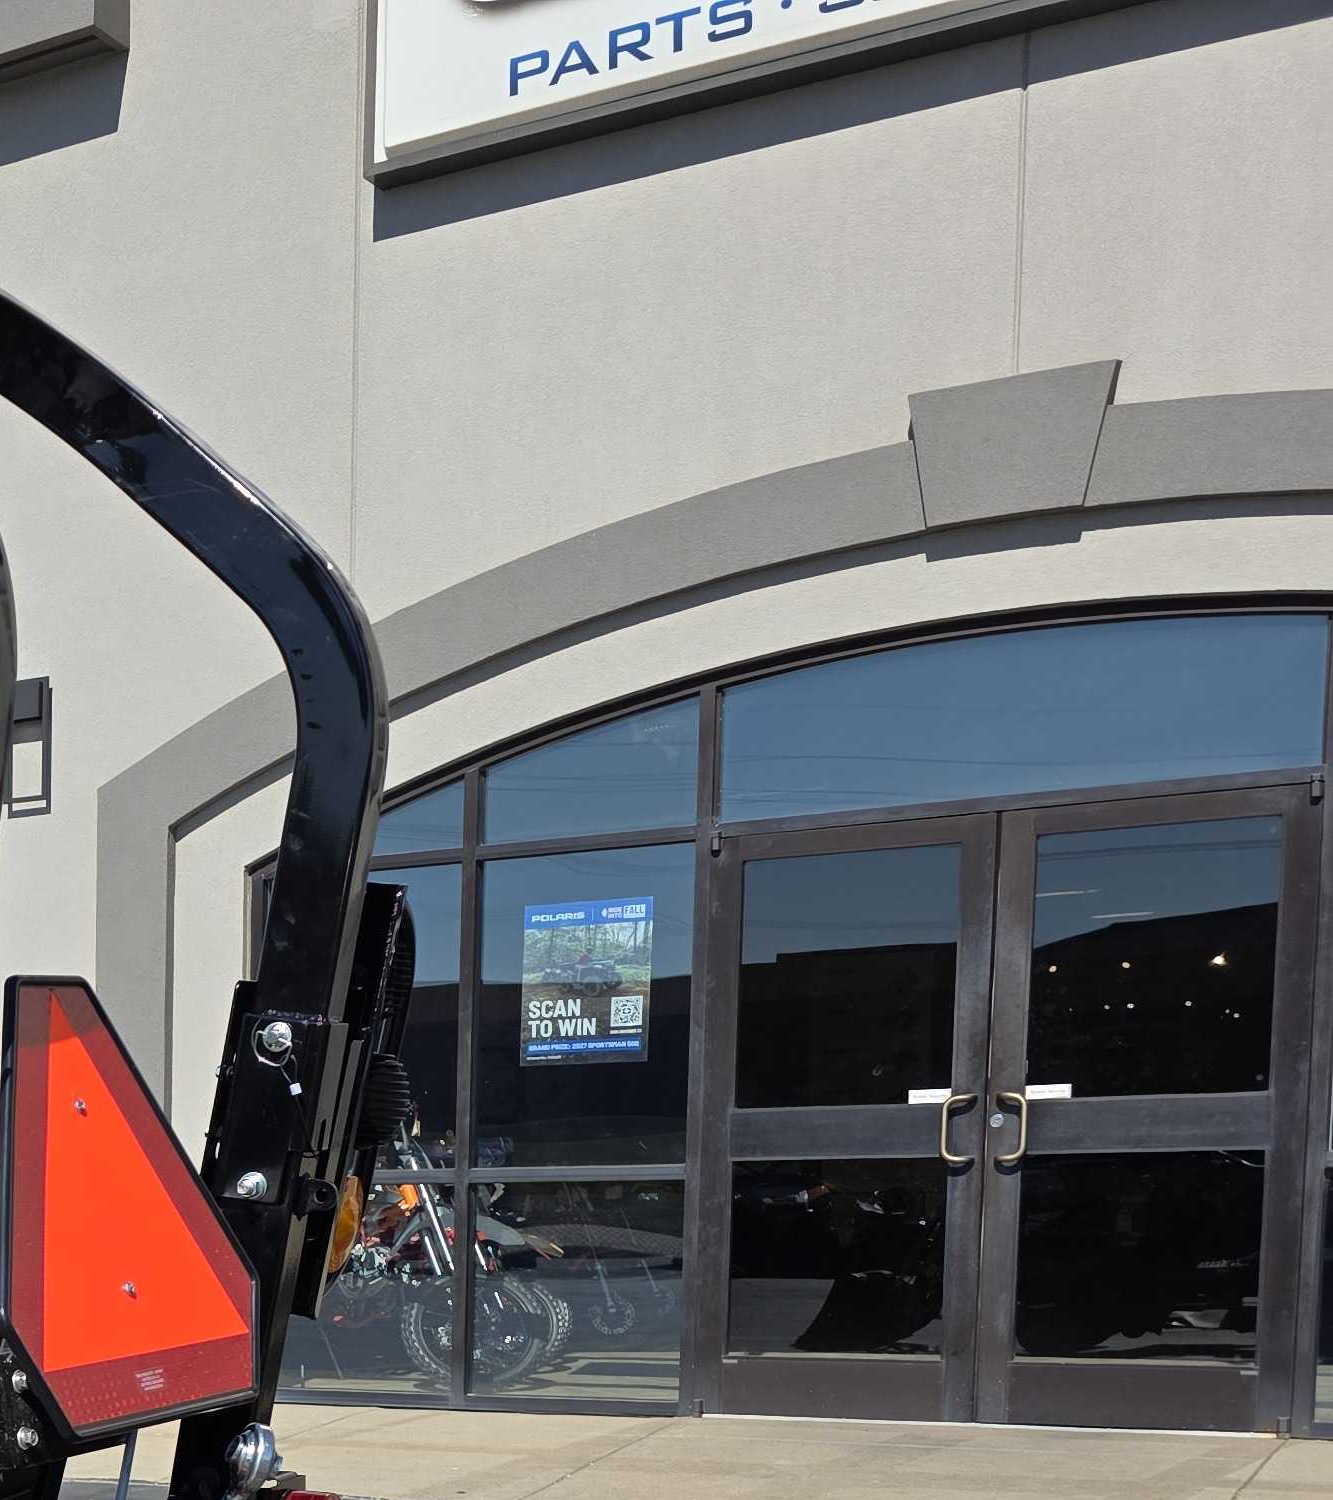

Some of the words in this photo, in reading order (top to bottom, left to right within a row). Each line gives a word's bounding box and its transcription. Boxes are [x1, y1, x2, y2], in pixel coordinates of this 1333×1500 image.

[507, 0, 754, 97] PARTS
[531, 911, 585, 922] POLARIS
[625, 904, 645, 914] FALL
[528, 999, 581, 1019] SCAN
[528, 1019, 553, 1038] TO
[558, 1017, 597, 1036] WIN
